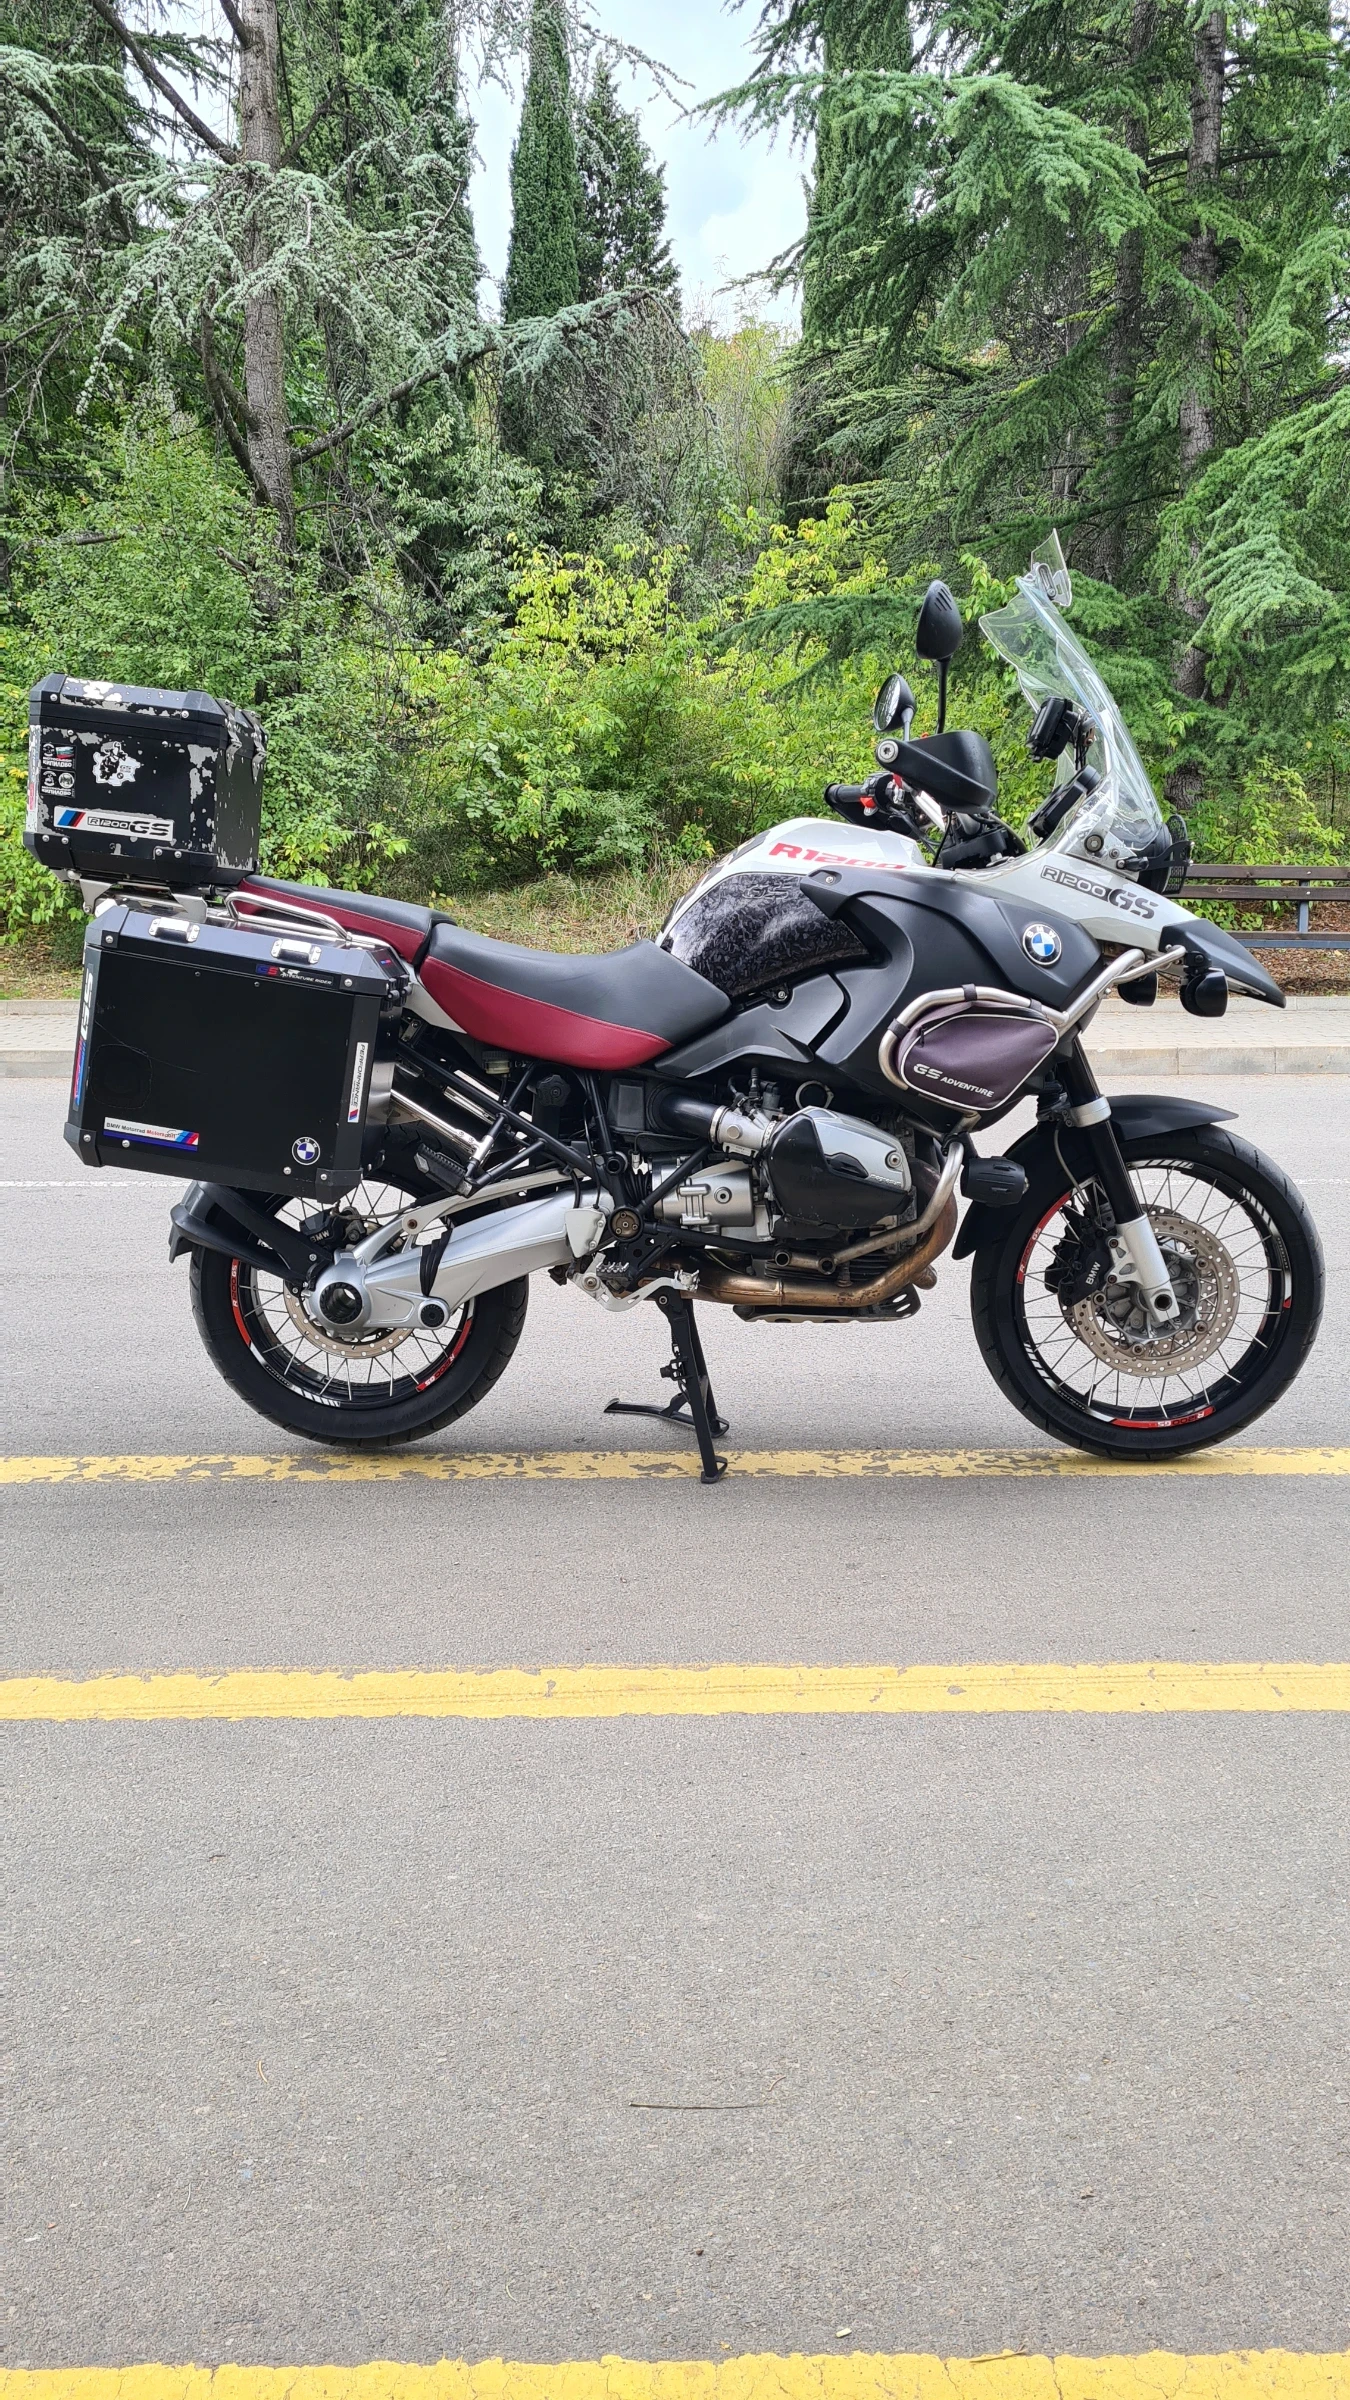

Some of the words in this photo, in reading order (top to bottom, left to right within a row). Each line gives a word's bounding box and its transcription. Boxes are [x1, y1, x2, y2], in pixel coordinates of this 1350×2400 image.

[768, 842, 907, 870] R1200
[353, 1044, 366, 1108] PERFORMANCE
[913, 1063, 943, 1080] GS
[940, 1076, 995, 1098] ADVENTURE
[106, 1122, 121, 1130] BMW
[121, 1125, 145, 1134] Motorrad
[310, 1230, 330, 1242] BMW
[1085, 1261, 1102, 1285] BMW
